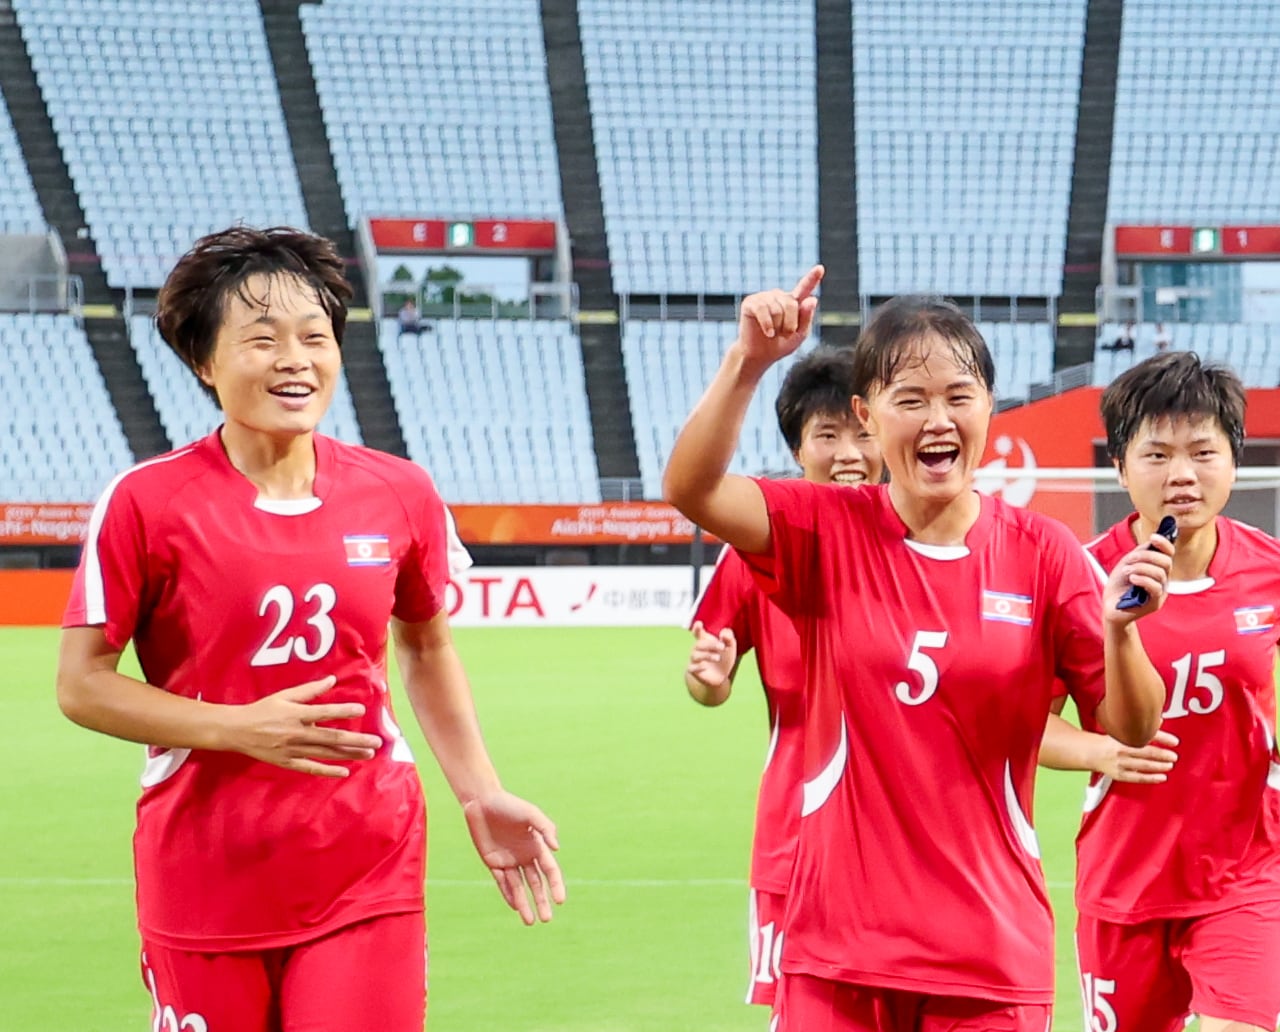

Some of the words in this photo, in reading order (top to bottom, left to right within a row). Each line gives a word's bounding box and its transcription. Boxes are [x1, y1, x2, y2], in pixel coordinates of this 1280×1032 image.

[250, 582, 337, 667] 23
[895, 629, 950, 706] 5
[1161, 648, 1226, 719] 15
